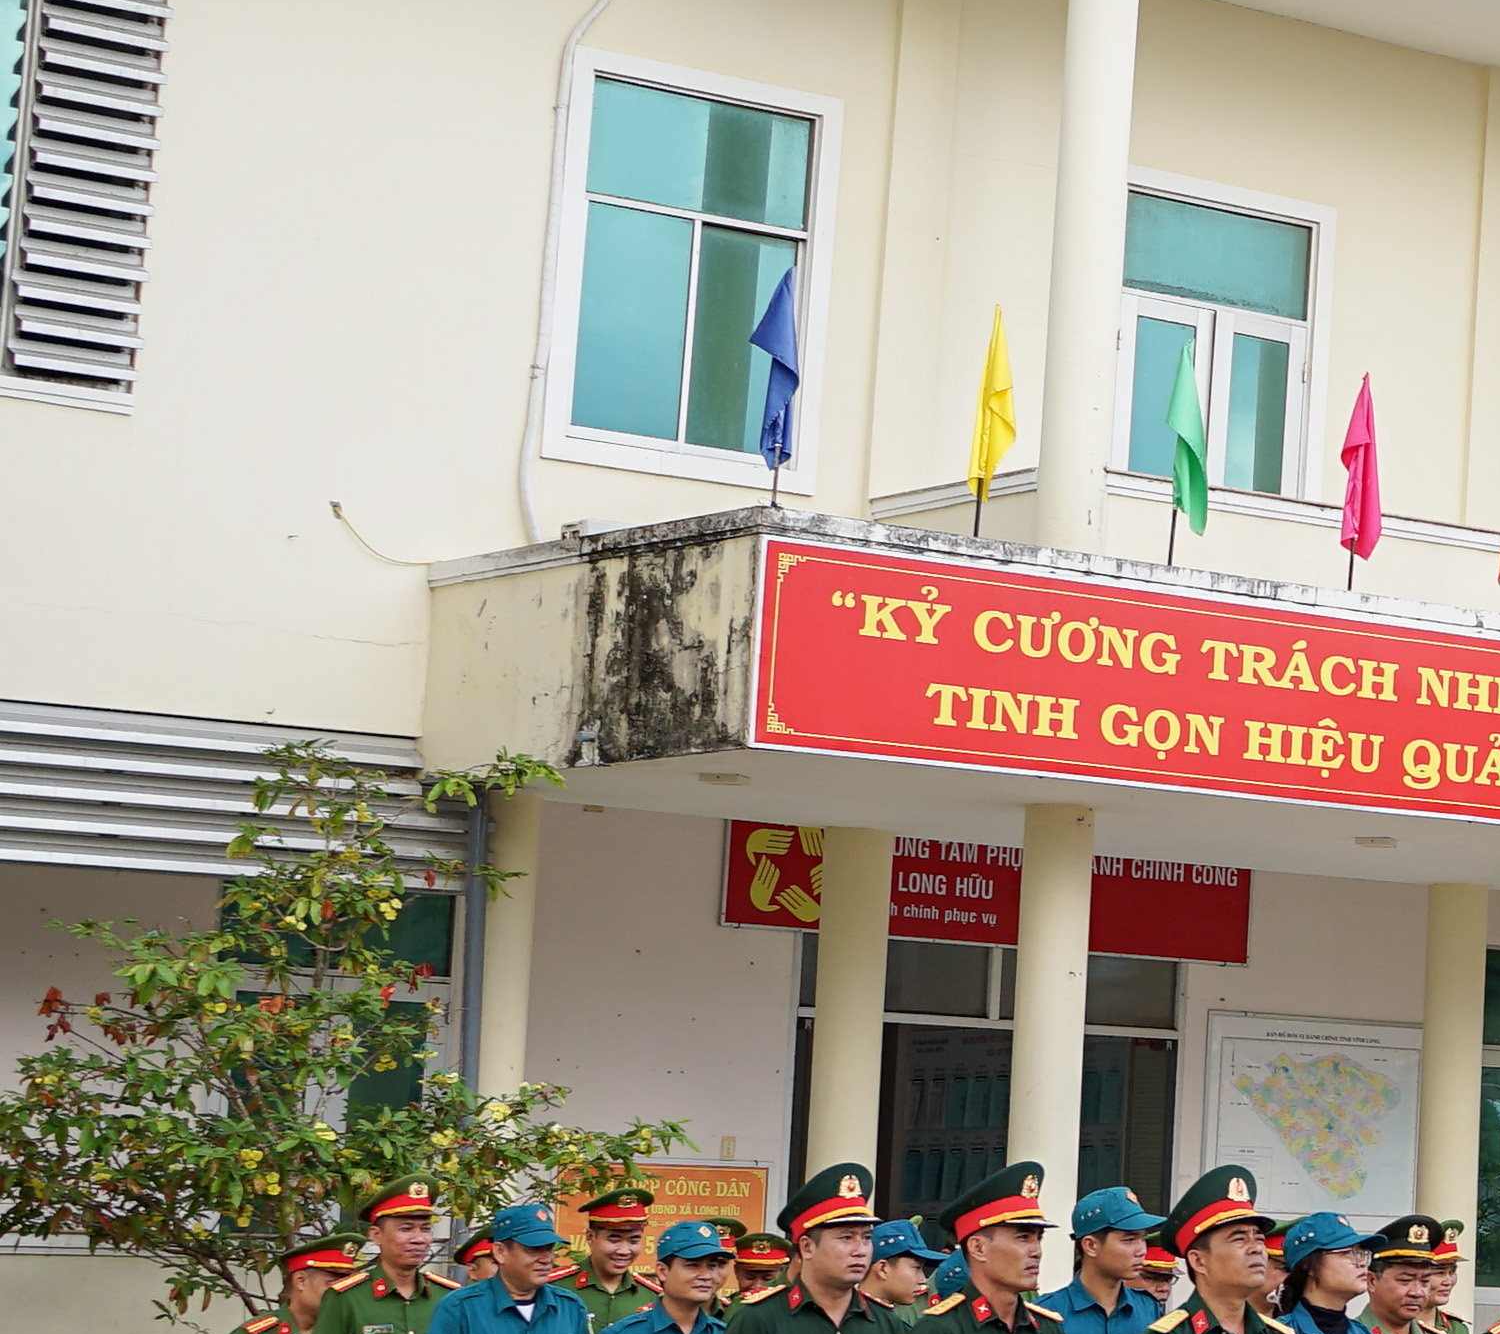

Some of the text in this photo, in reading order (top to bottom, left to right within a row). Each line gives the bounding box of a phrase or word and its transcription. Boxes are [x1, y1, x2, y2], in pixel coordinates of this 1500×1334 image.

[974, 607, 1181, 674] CƯƠNG
[1201, 636, 1399, 701] TRÁCH
[926, 683, 1080, 739] TINH
[1101, 704, 1224, 760] GỌN
[1243, 718, 1384, 778] HIỆU
[898, 872, 994, 899] LONG HỮU
[903, 904, 939, 920] chính
[945, 908, 977, 925] phục
[982, 913, 997, 927] vụ
[664, 1175, 711, 1197] CÔNG
[715, 1178, 752, 1198] DÂN
[651, 1205, 676, 1215] UBND
[679, 1202, 693, 1215] XÃ
[694, 1205, 719, 1216] LONG
